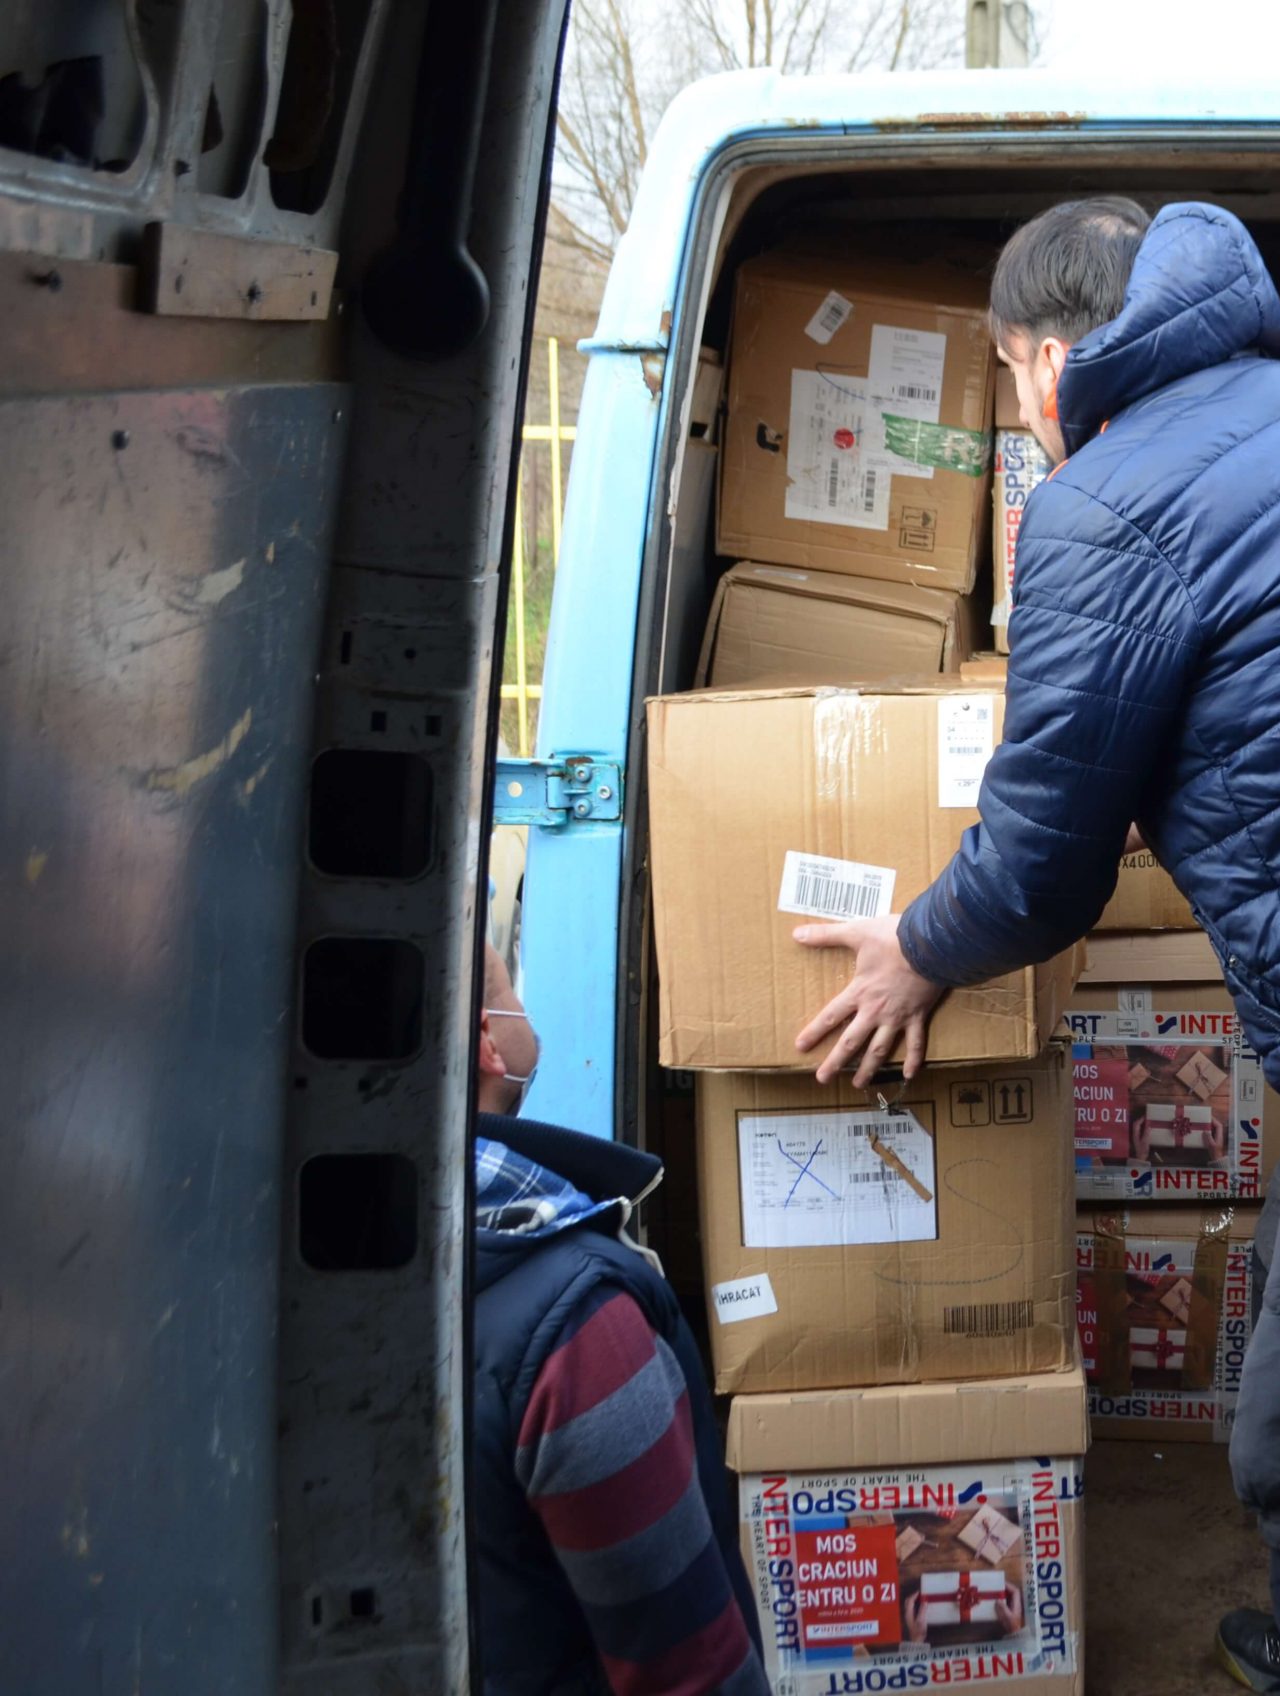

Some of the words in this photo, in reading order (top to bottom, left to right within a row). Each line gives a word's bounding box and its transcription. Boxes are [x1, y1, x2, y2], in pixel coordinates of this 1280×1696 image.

[1181, 1014, 1233, 1035] INTE
[1115, 1108, 1127, 1123] ZI
[792, 1483, 954, 1515] INTERSPO
[816, 1534, 857, 1555] MOS
[798, 1558, 878, 1582] CRACIUN
[1032, 1471, 1066, 1657] INTERSPORT
[795, 1586, 857, 1607] ENTRU
[862, 1584, 875, 1601] O
[880, 1583, 897, 1601] ZI
[825, 1651, 1025, 1695] INTERSPORT
